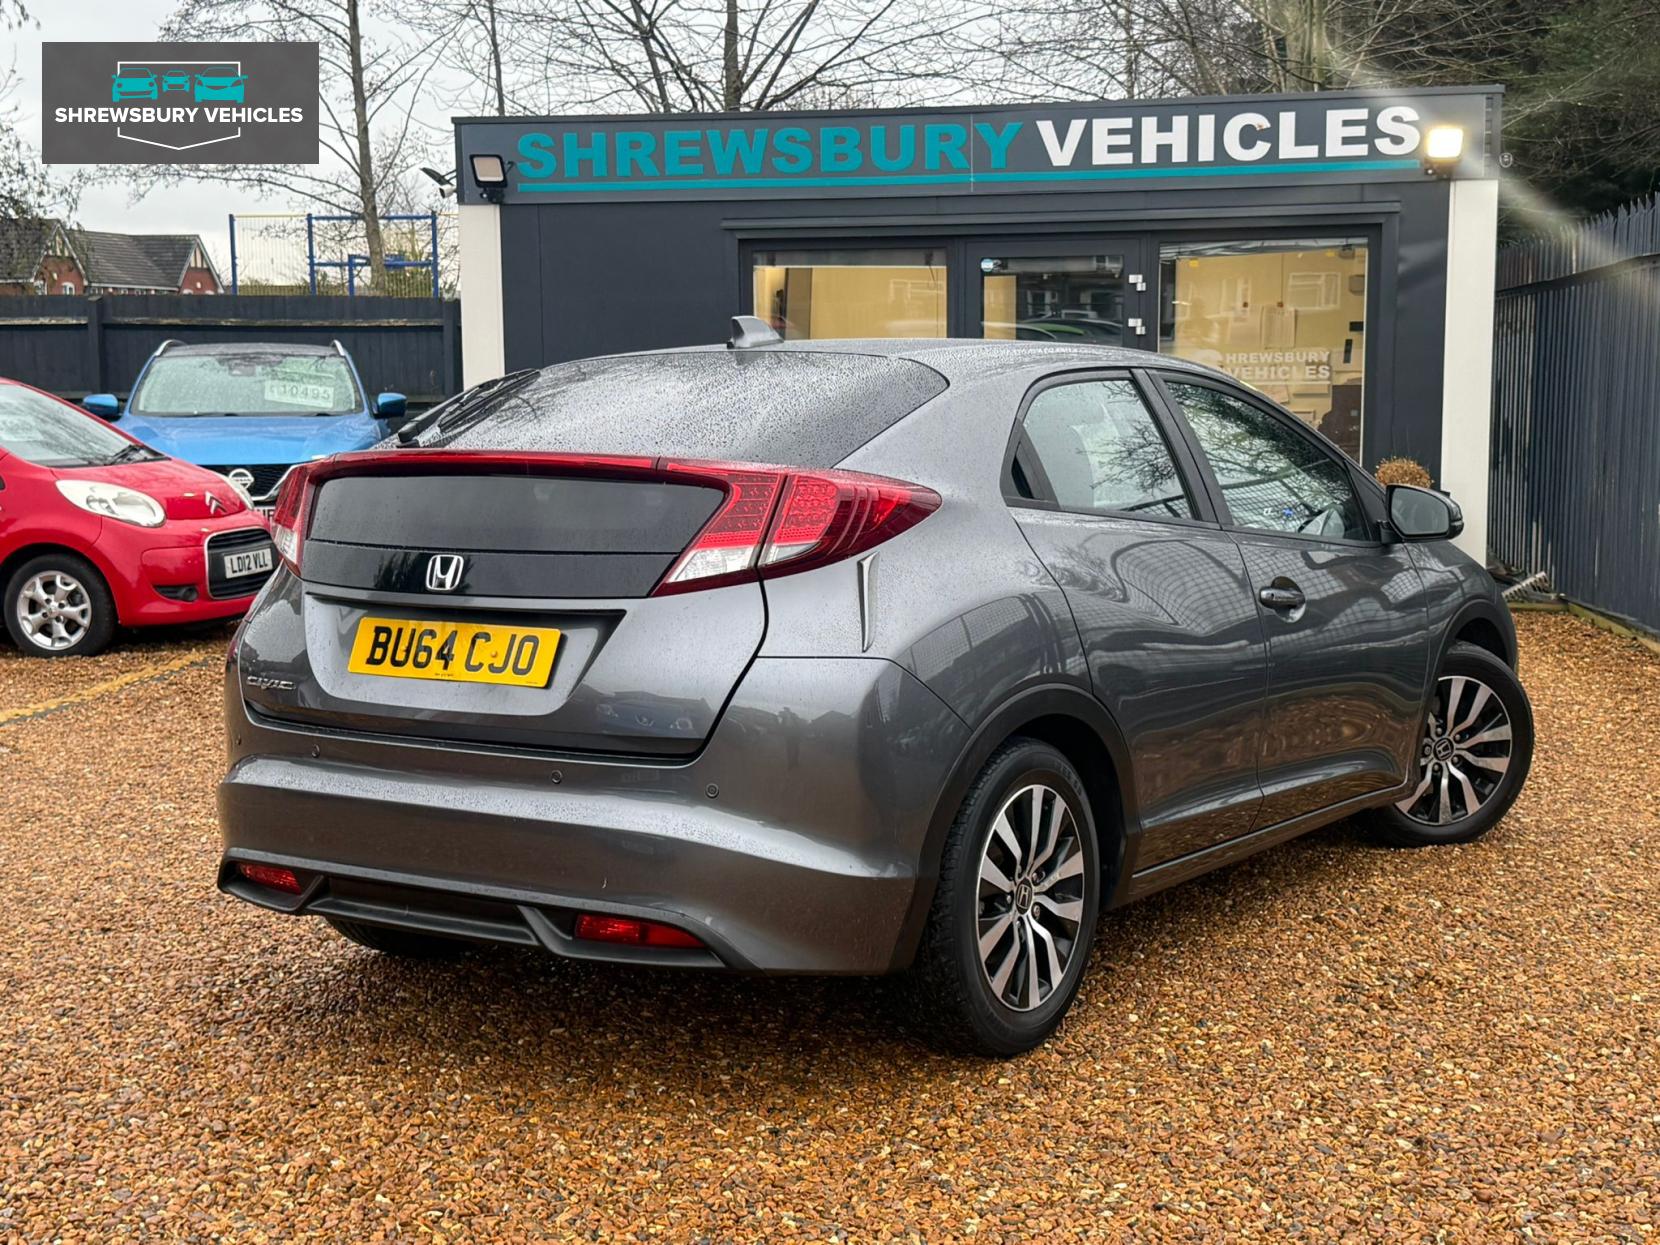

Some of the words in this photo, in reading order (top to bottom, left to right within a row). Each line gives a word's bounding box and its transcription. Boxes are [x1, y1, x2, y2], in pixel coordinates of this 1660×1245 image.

[517, 122, 1023, 178] SHREWSBURY
[1036, 106, 1420, 166] VEHICLES
[1228, 365, 1331, 380] VEHICLES
[230, 554, 252, 574] LD12
[365, 626, 458, 670] BU64
